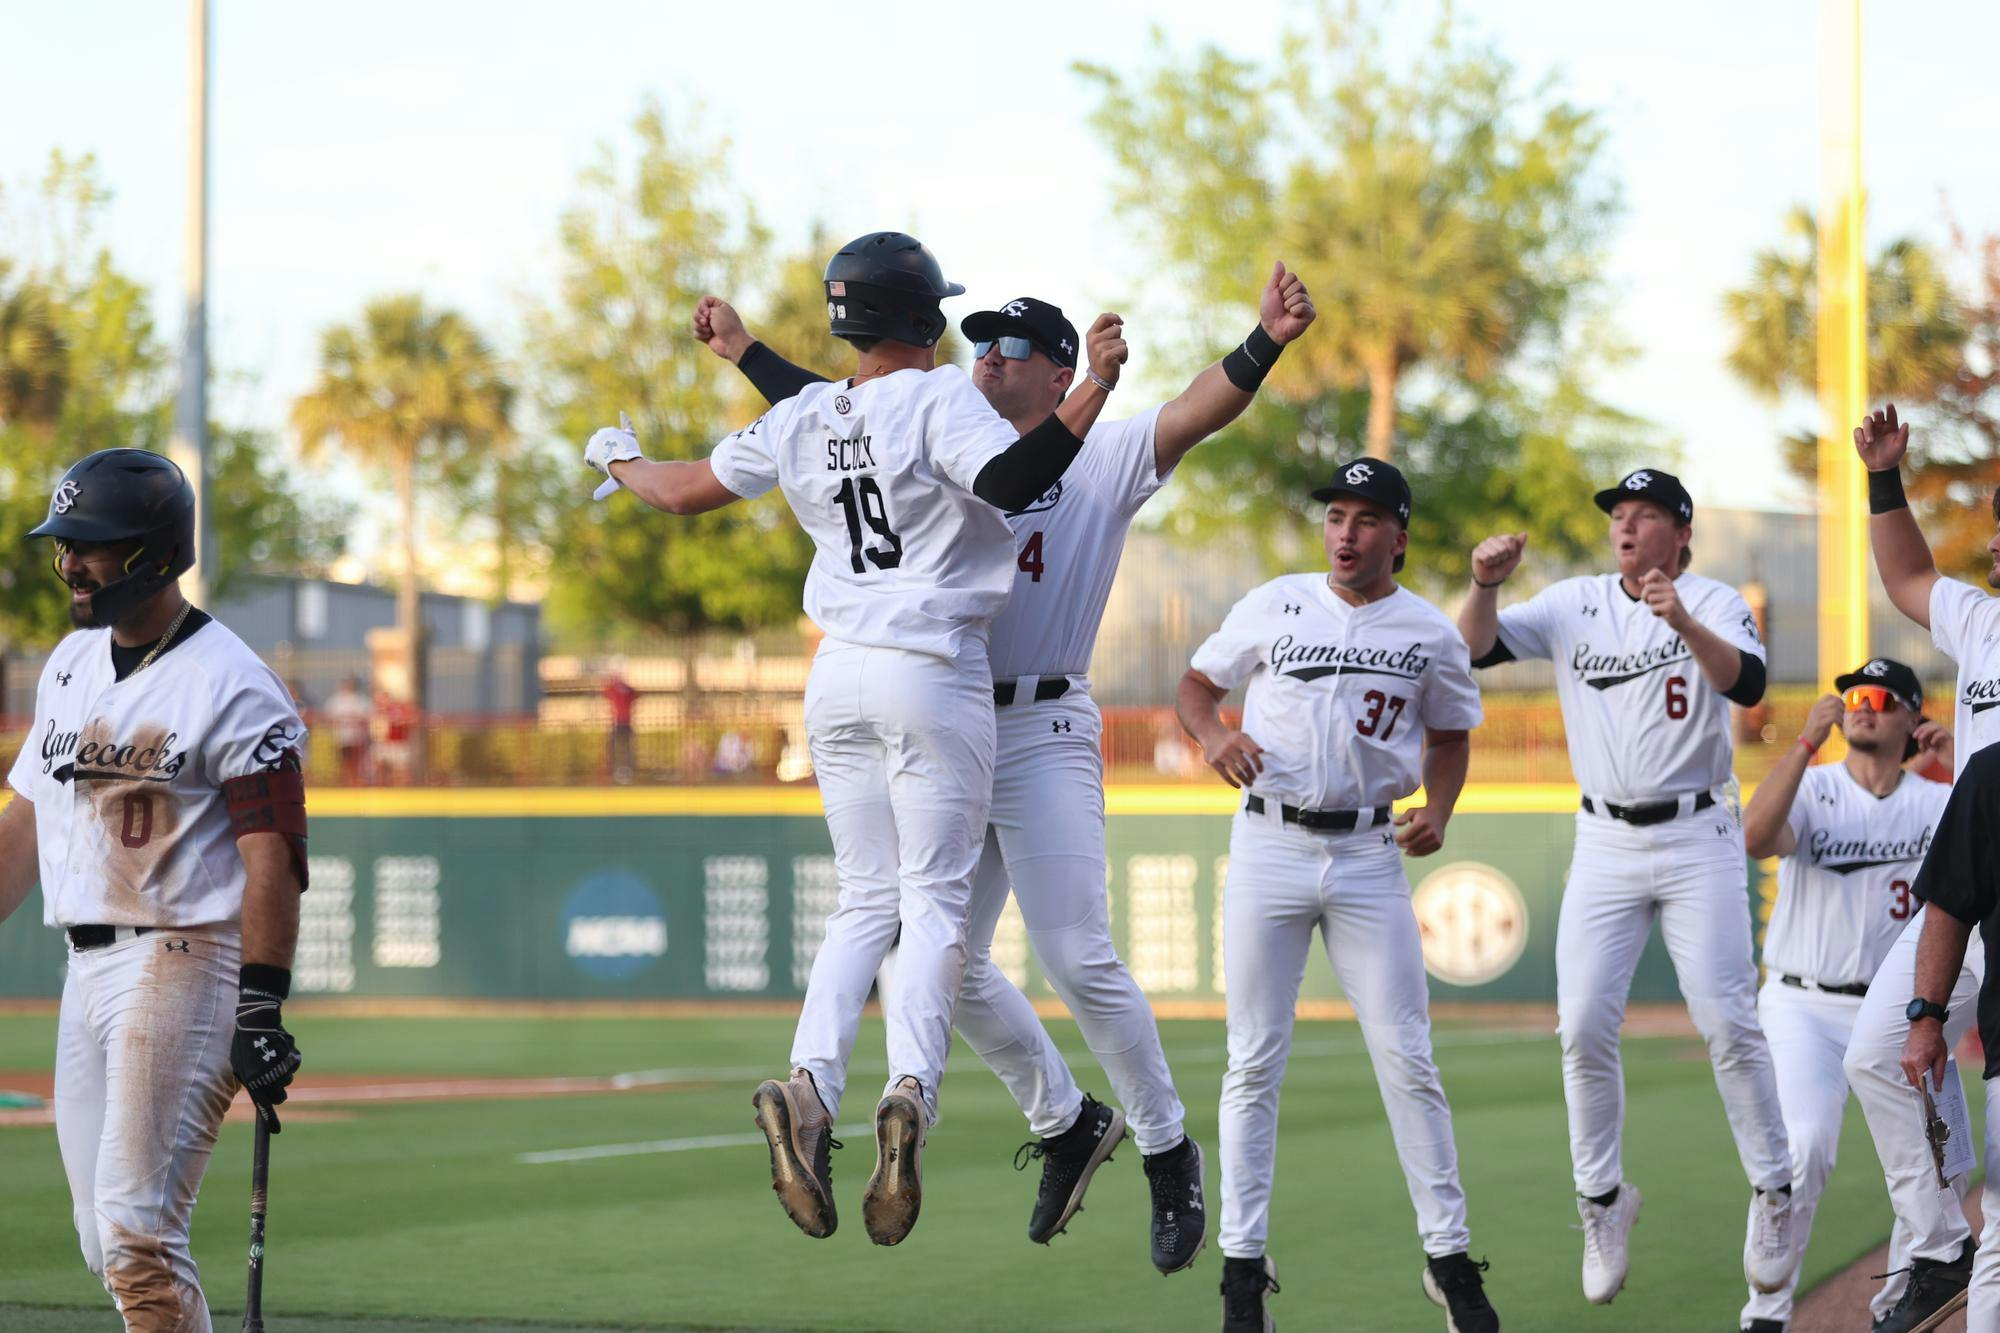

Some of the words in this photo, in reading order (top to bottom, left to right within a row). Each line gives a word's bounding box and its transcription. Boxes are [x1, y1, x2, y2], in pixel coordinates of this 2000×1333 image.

[833, 477, 903, 574] 19
[1014, 531, 1045, 583] 4
[1271, 634, 1430, 677] Gamecocks
[1573, 634, 1688, 681] Gamecock
[1356, 689, 1407, 742] 37
[1665, 676, 1688, 720] 6
[121, 793, 153, 849] 0
[1810, 825, 1931, 864] Gamecock
[1889, 880, 1920, 921] 3
